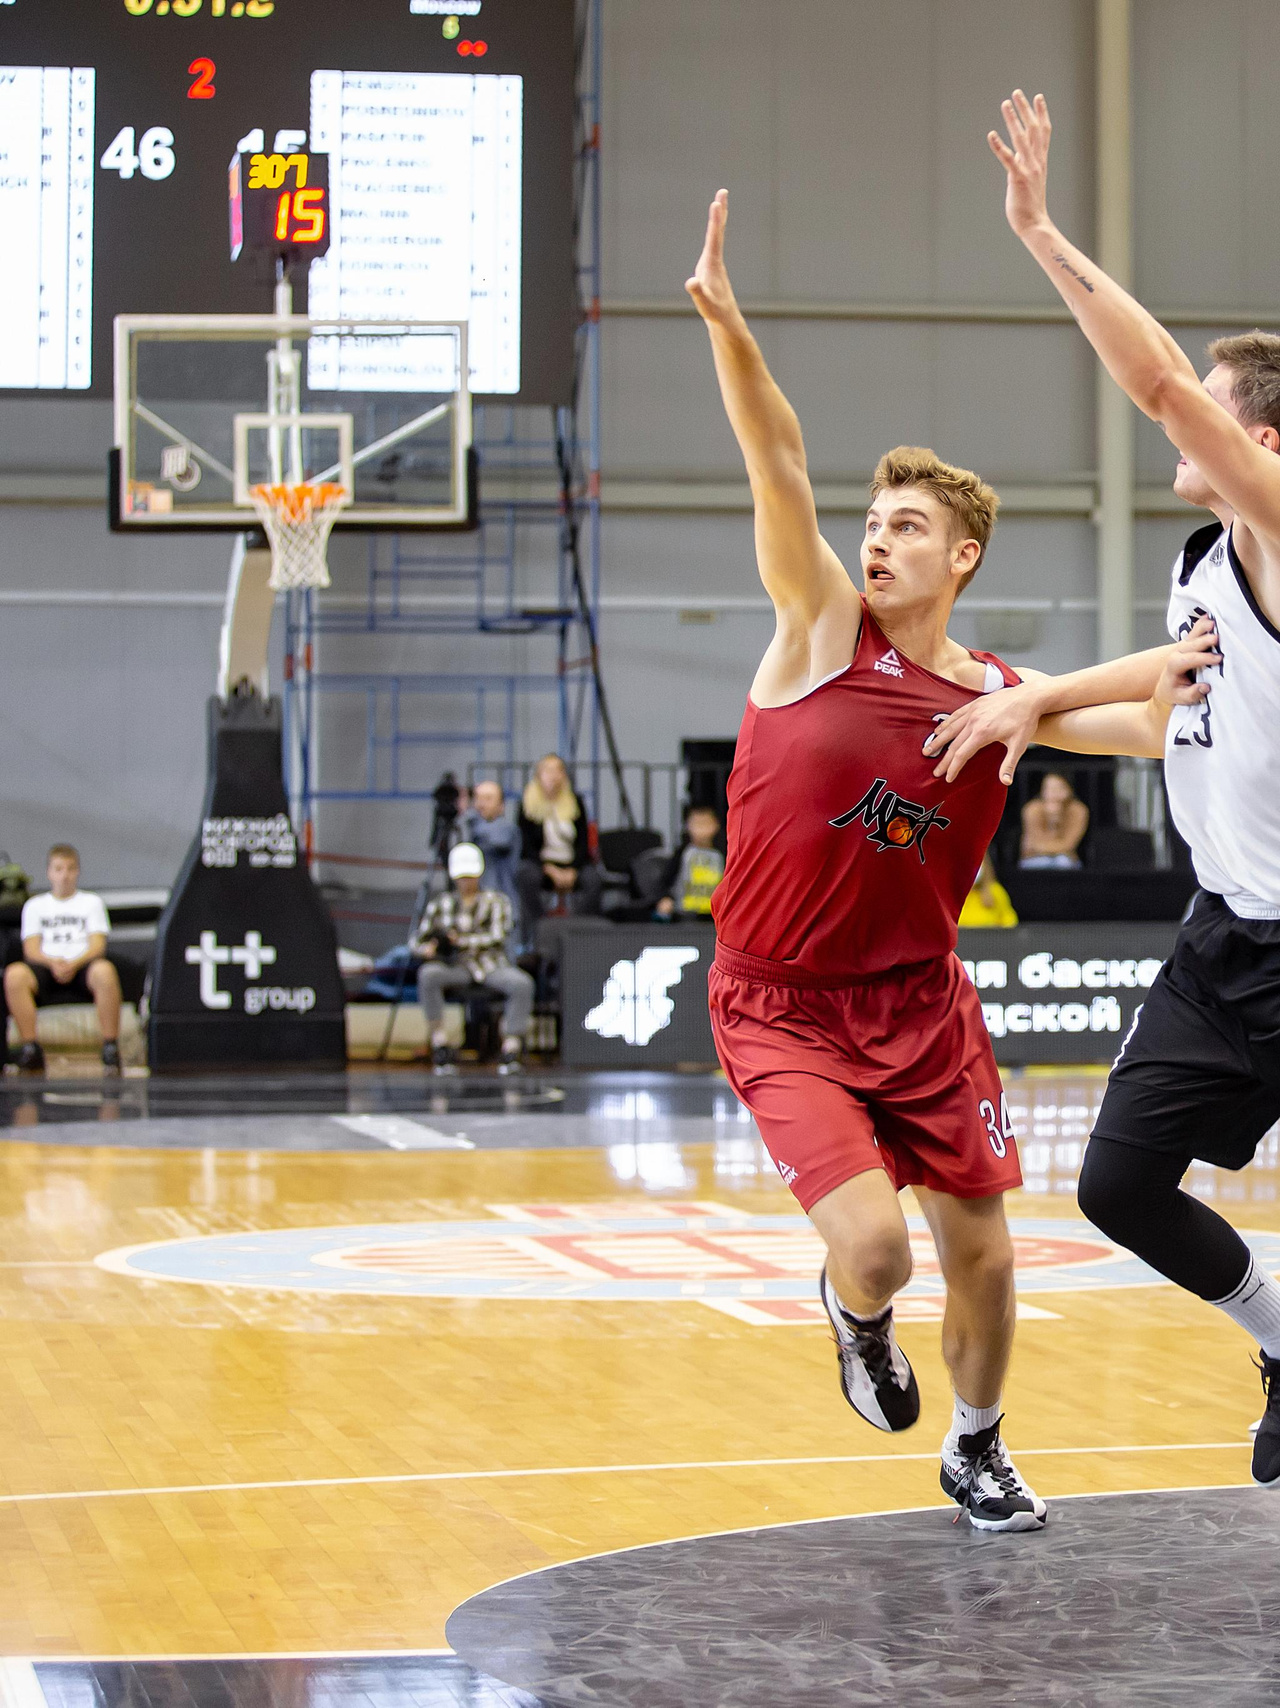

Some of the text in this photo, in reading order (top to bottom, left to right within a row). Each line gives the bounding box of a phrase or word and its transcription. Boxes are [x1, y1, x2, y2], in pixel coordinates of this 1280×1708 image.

[187, 58, 216, 99] 2
[100, 126, 176, 180] 46
[275, 188, 325, 242] 15
[873, 660, 905, 679] PEAK
[244, 986, 316, 1015] group
[978, 1091, 1015, 1159] 34
